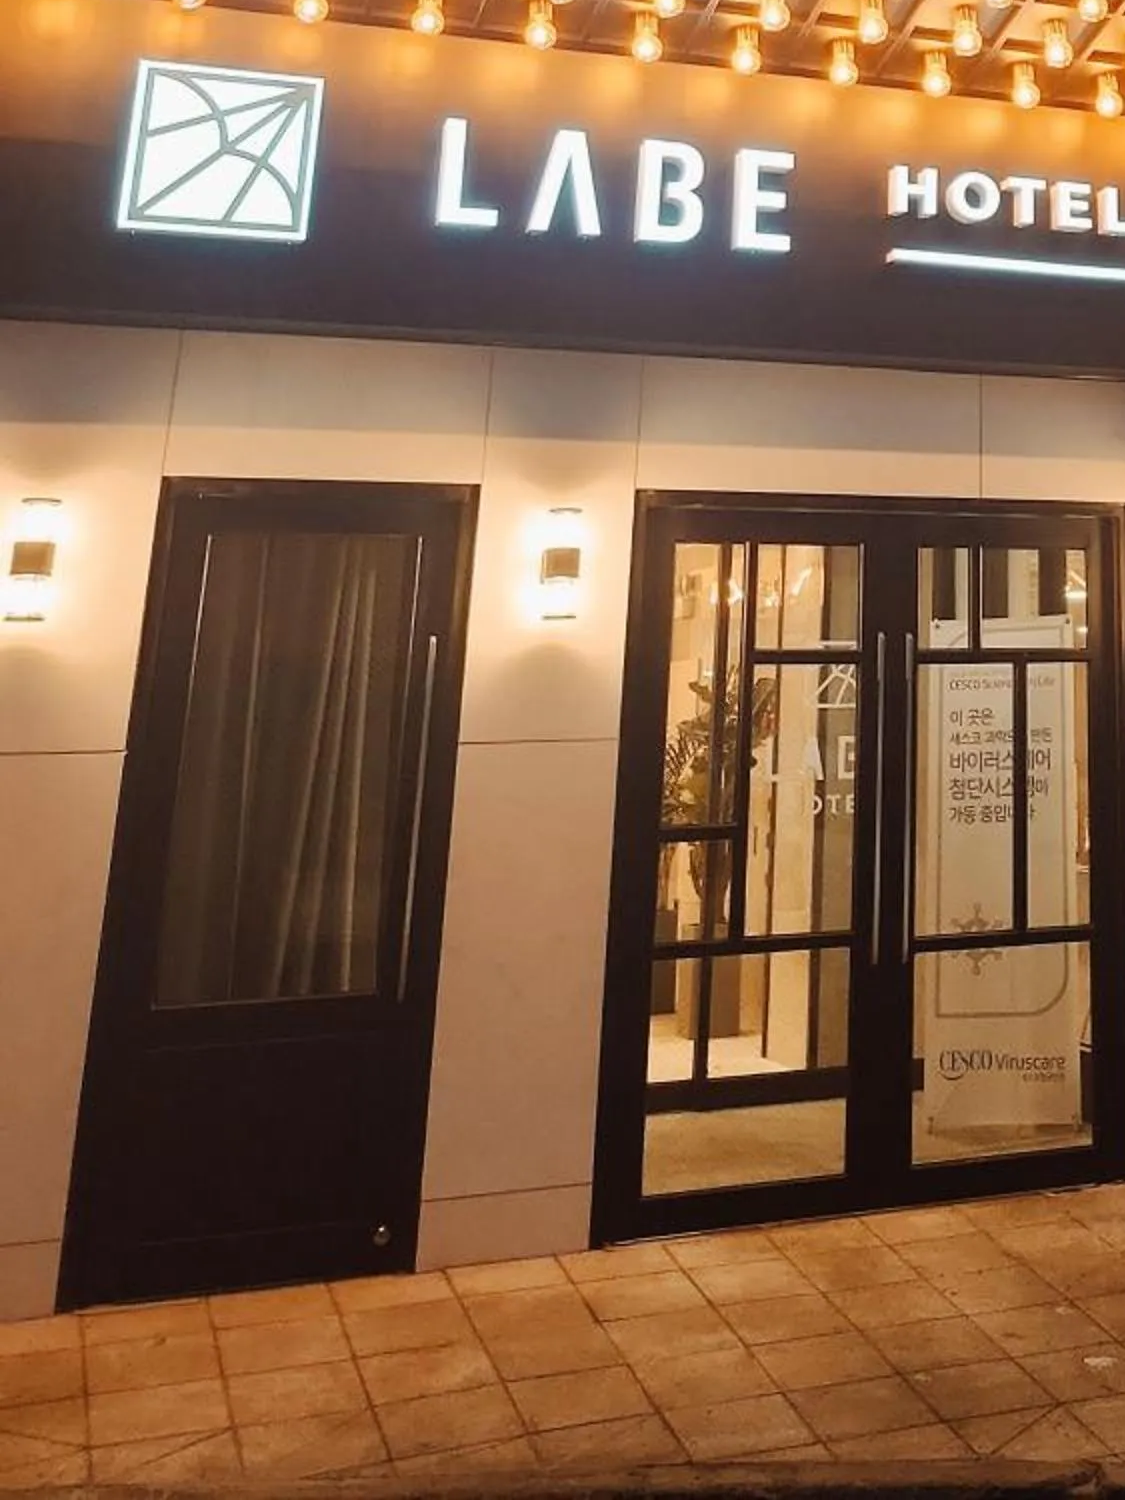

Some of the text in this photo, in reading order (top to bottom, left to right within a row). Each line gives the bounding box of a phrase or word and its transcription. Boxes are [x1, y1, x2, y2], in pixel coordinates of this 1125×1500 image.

[434, 117, 796, 253] LABE
[939, 1049, 1066, 1076] CESCO Viruscare
